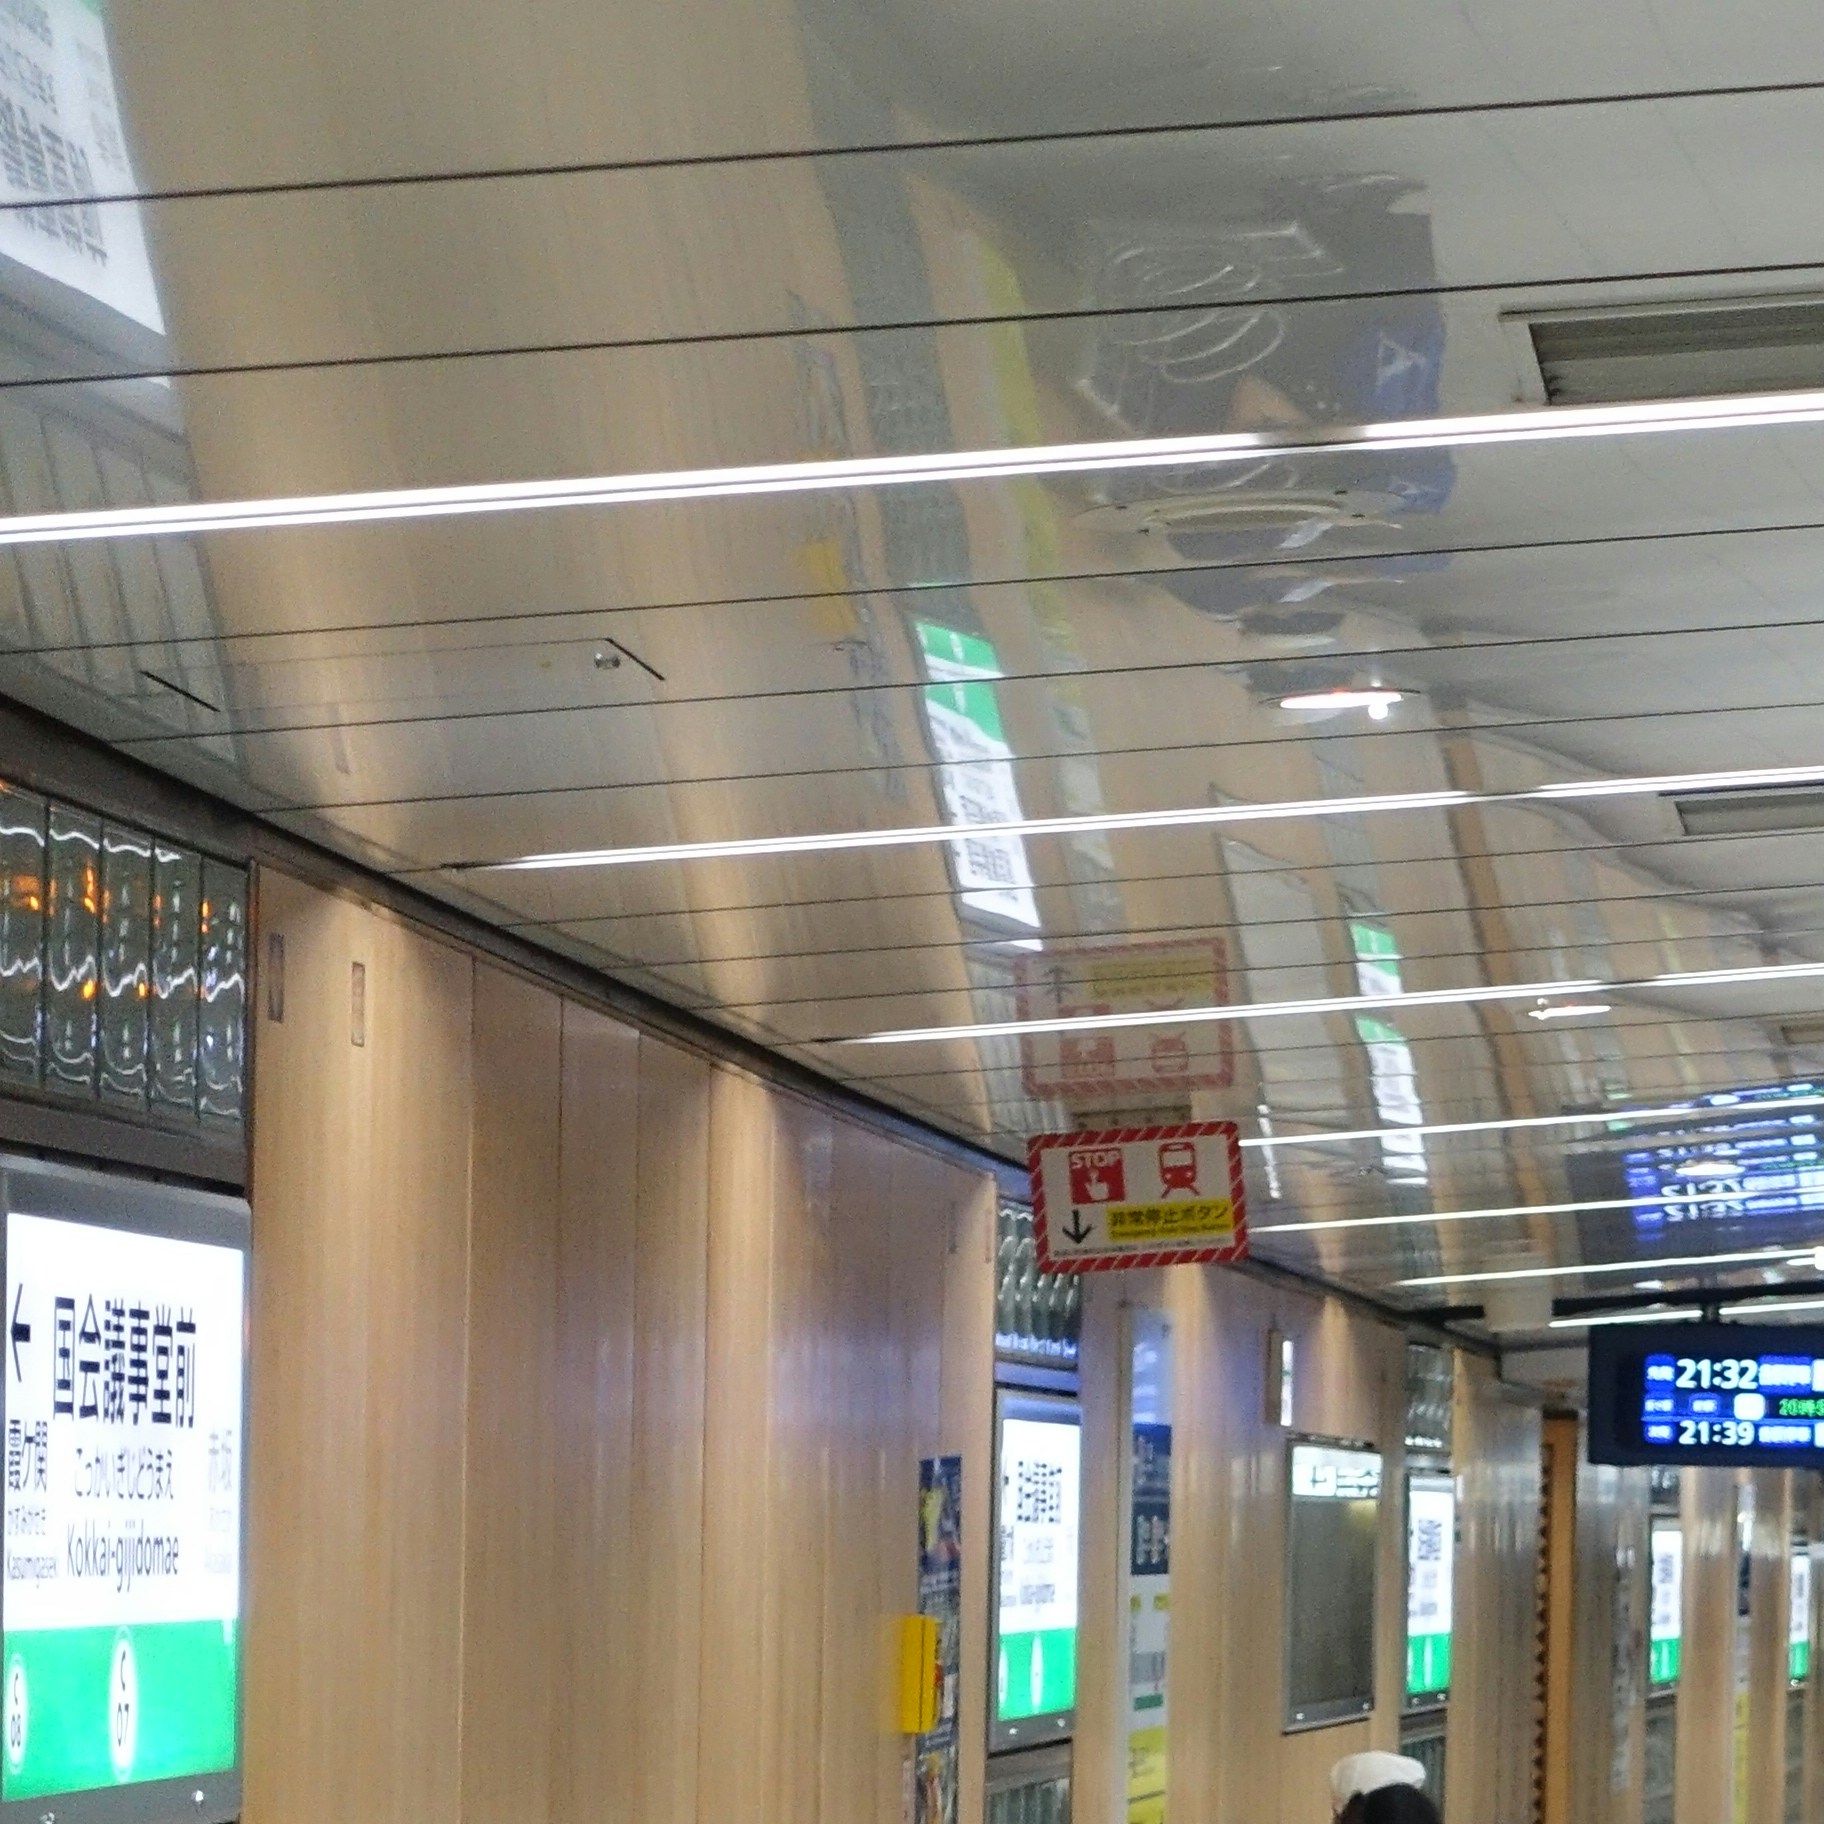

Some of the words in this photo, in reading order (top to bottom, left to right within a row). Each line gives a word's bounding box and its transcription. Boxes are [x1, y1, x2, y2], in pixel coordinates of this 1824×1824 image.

[1071, 1150, 1120, 1169] STOP
[53, 1293, 196, 1428] 国会議事堂前
[1676, 1358, 1758, 1390] 21:32
[1678, 1419, 1755, 1446] 21:39
[67, 1517, 180, 1593] Kokkai-gijidomae
